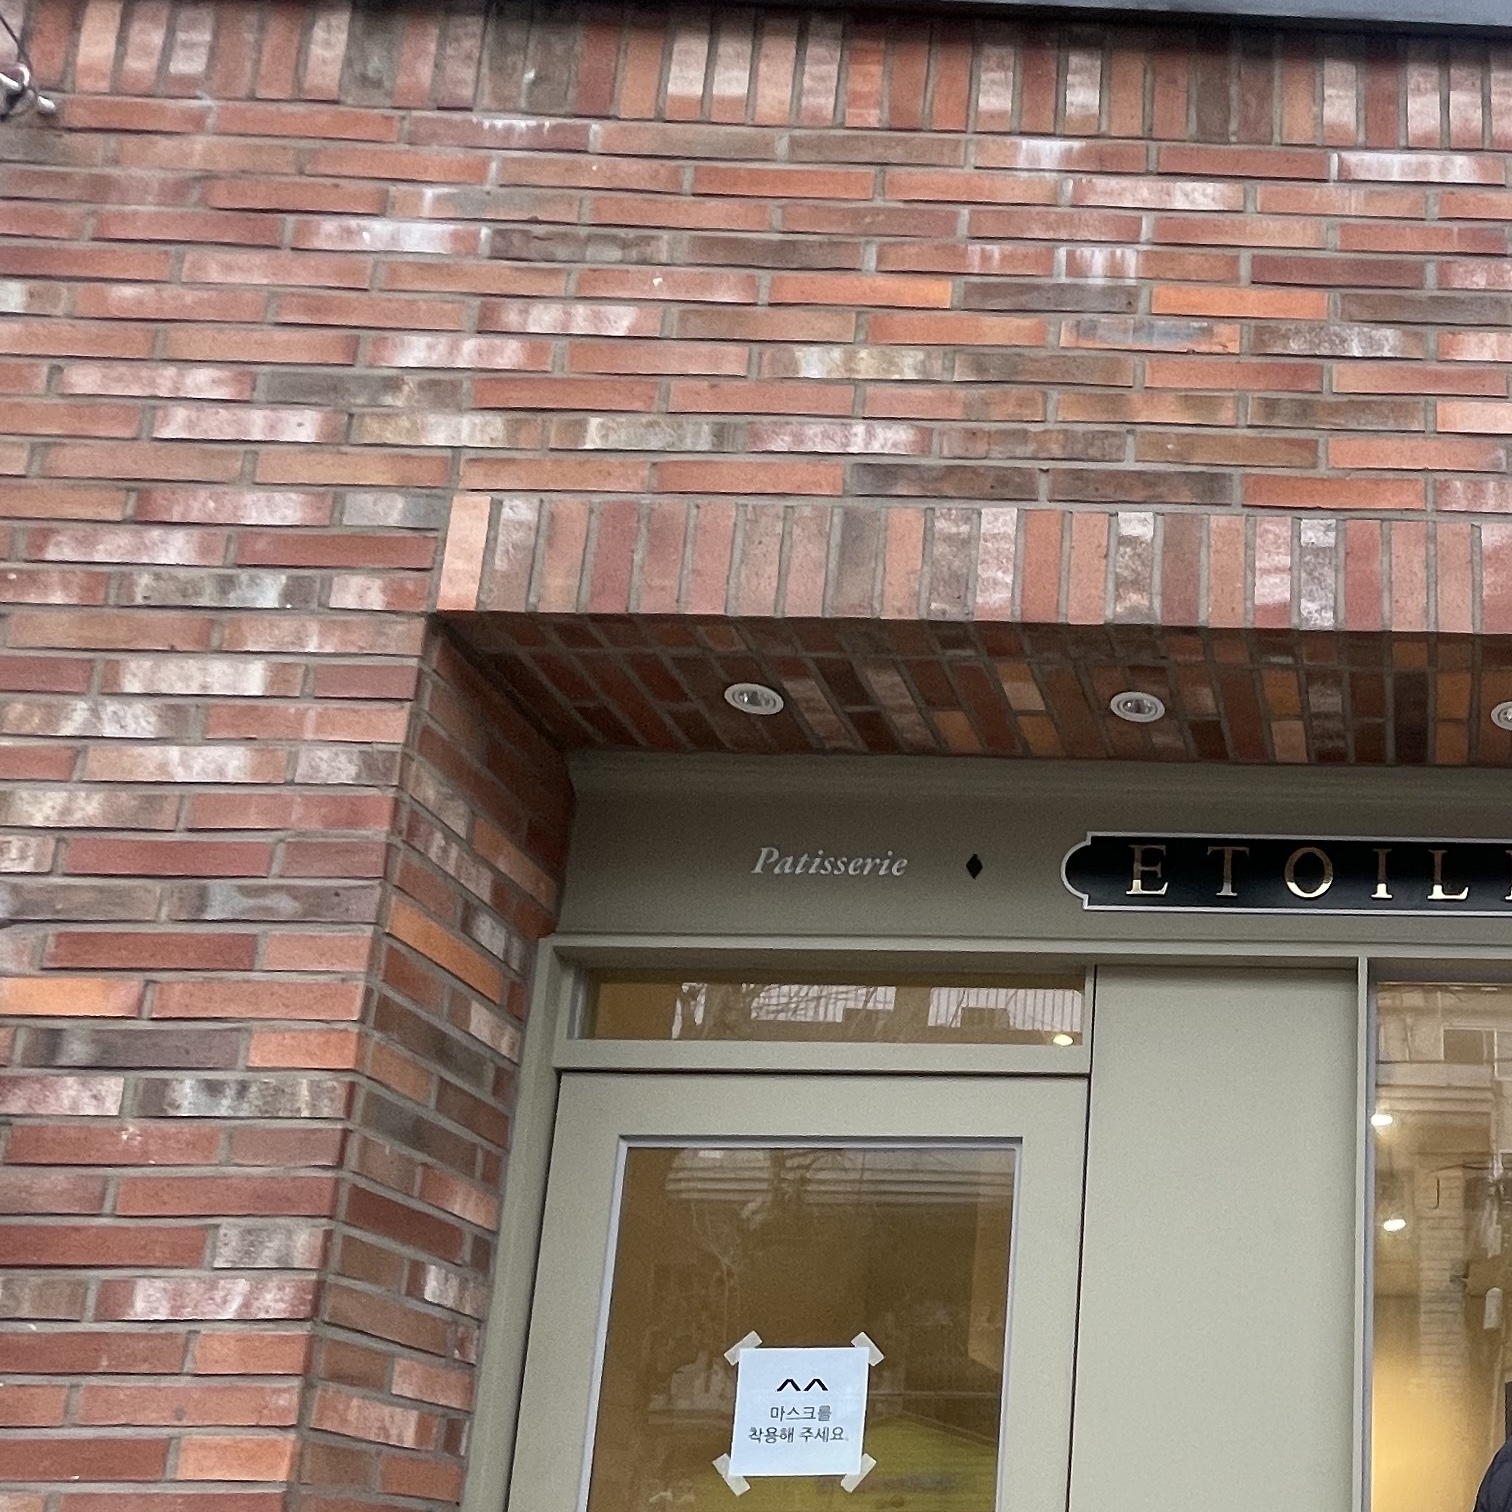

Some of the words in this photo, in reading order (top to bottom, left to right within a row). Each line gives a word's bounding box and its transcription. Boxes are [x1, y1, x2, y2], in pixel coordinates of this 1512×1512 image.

[752, 846, 909, 877] Patisserie
[770, 1405, 832, 1423] 마스크를
[749, 1426, 795, 1444] 착용해
